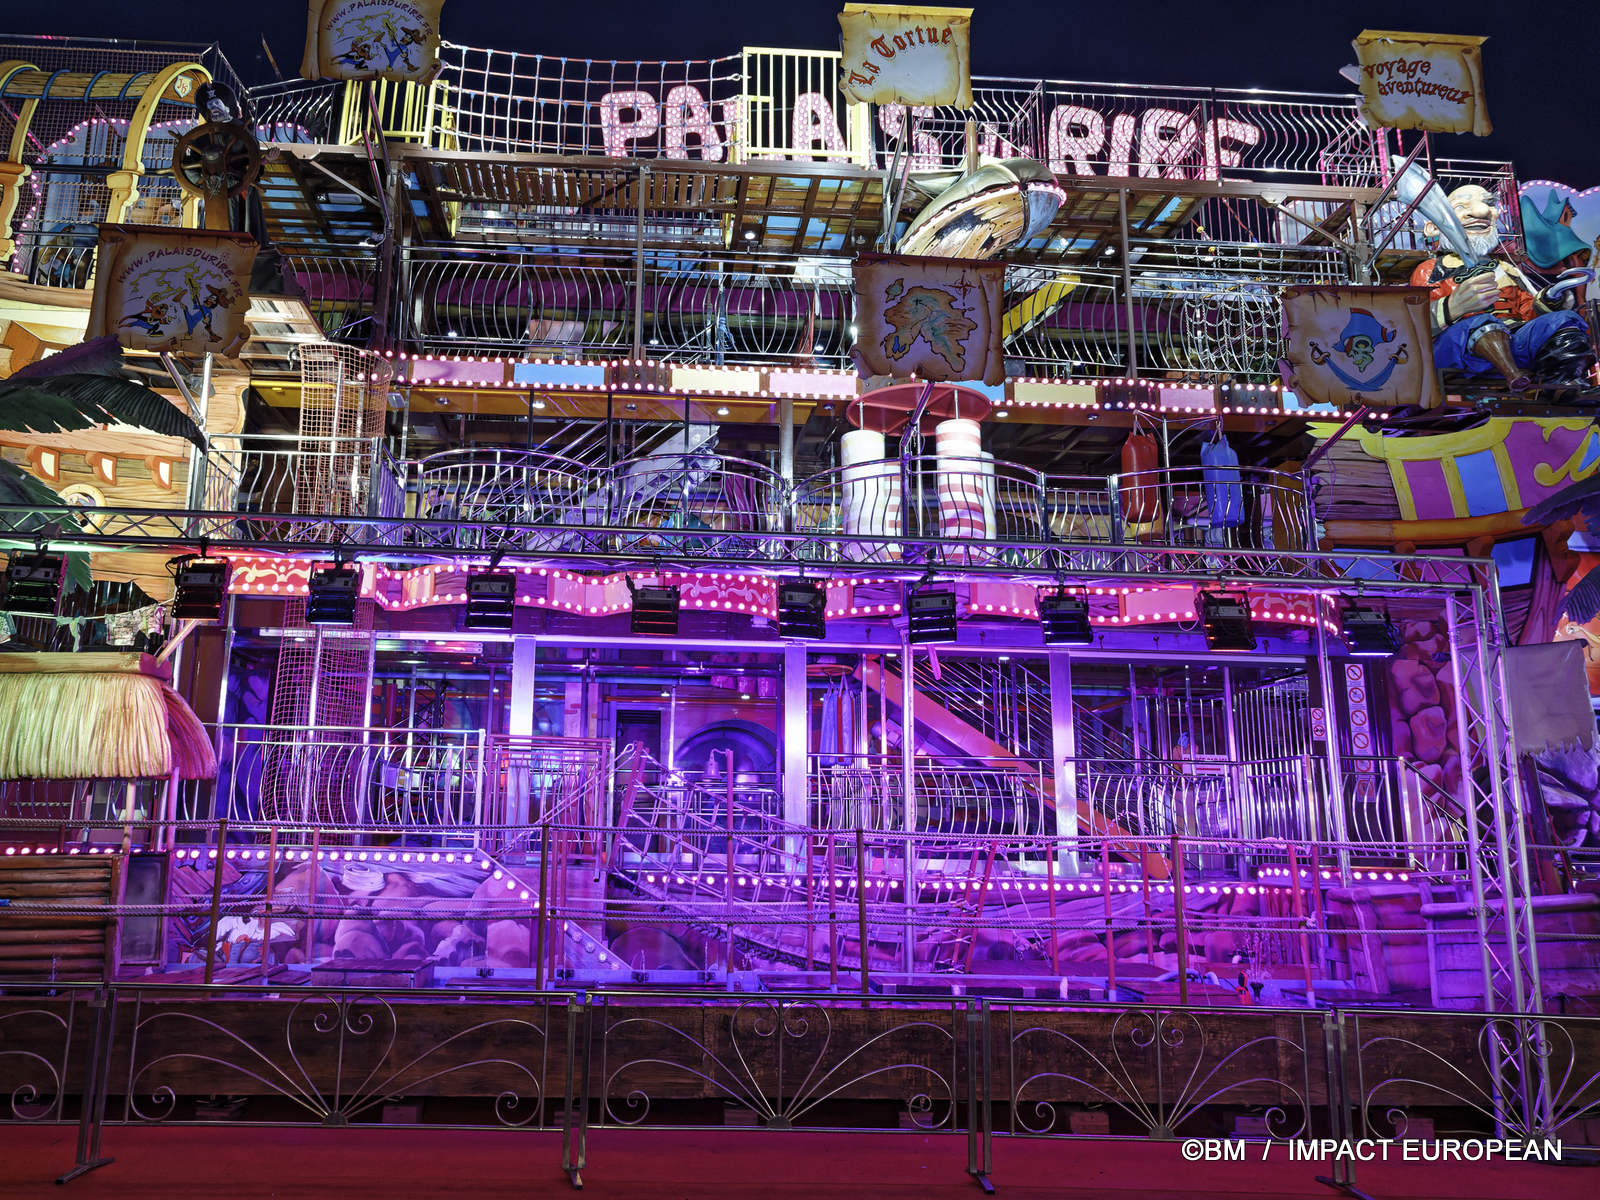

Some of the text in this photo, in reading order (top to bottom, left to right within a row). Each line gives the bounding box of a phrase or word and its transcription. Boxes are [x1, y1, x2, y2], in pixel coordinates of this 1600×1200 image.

[848, 25, 953, 86] La Tortue
[117, 247, 244, 299] WWW.PALAISDURIRE.FR
